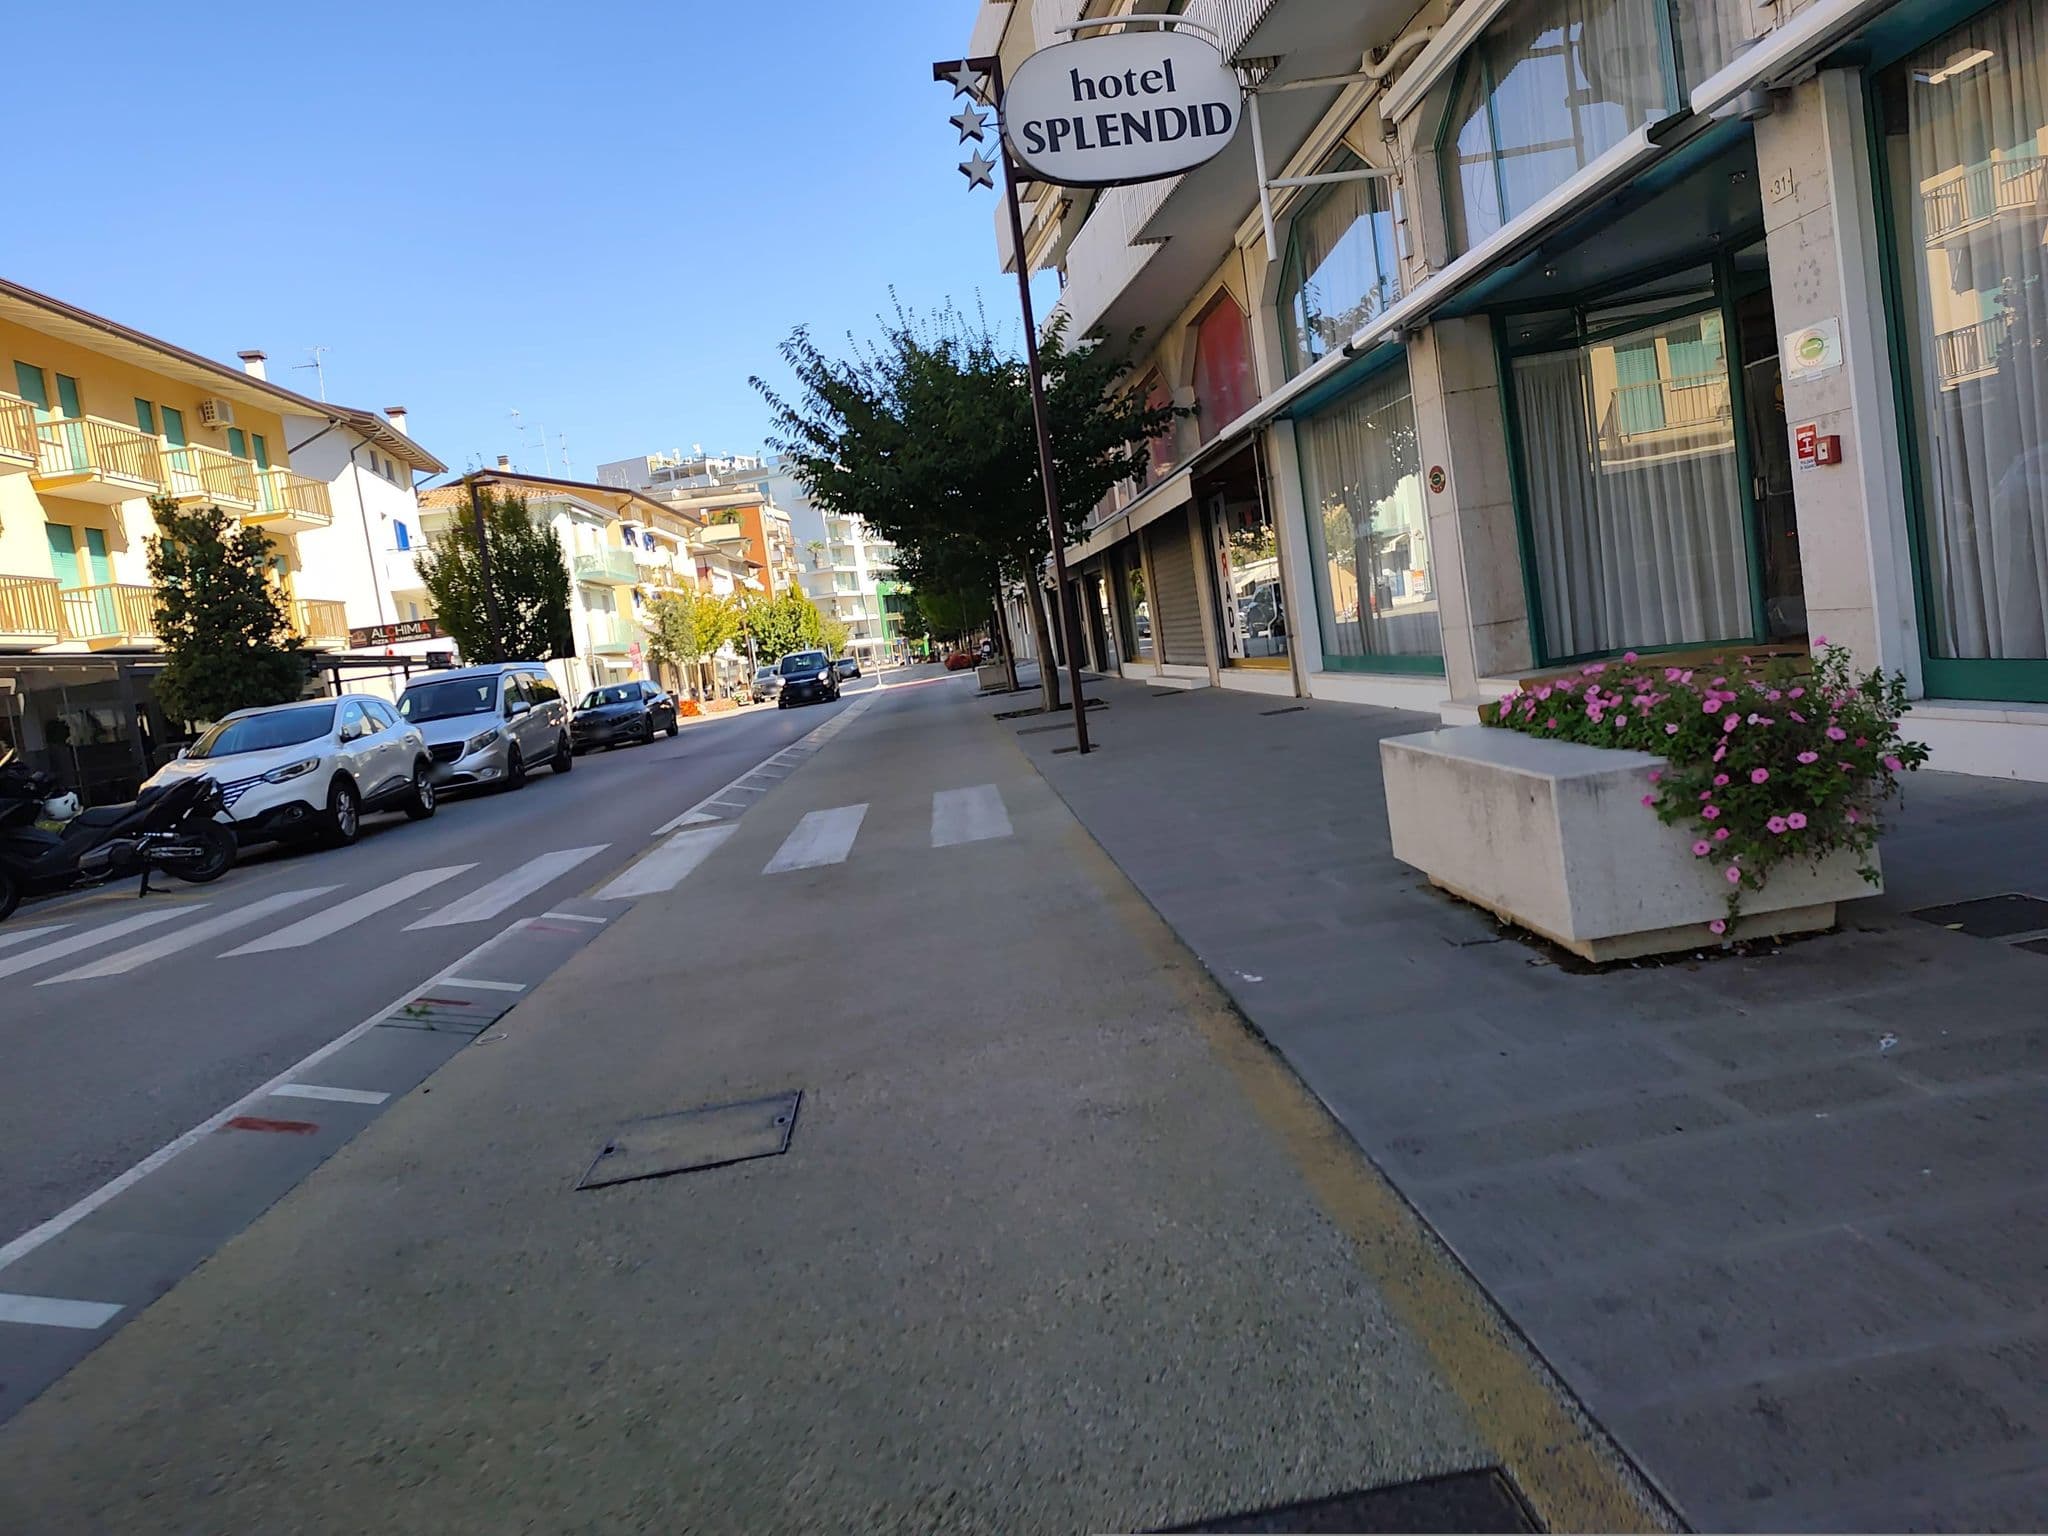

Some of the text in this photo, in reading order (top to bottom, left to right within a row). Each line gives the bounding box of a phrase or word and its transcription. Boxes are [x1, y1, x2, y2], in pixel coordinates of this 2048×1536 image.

[1069, 58, 1176, 101] hotel
[1022, 102, 1232, 154] SPLENDID
[372, 622, 430, 638] ALCHIMIA
